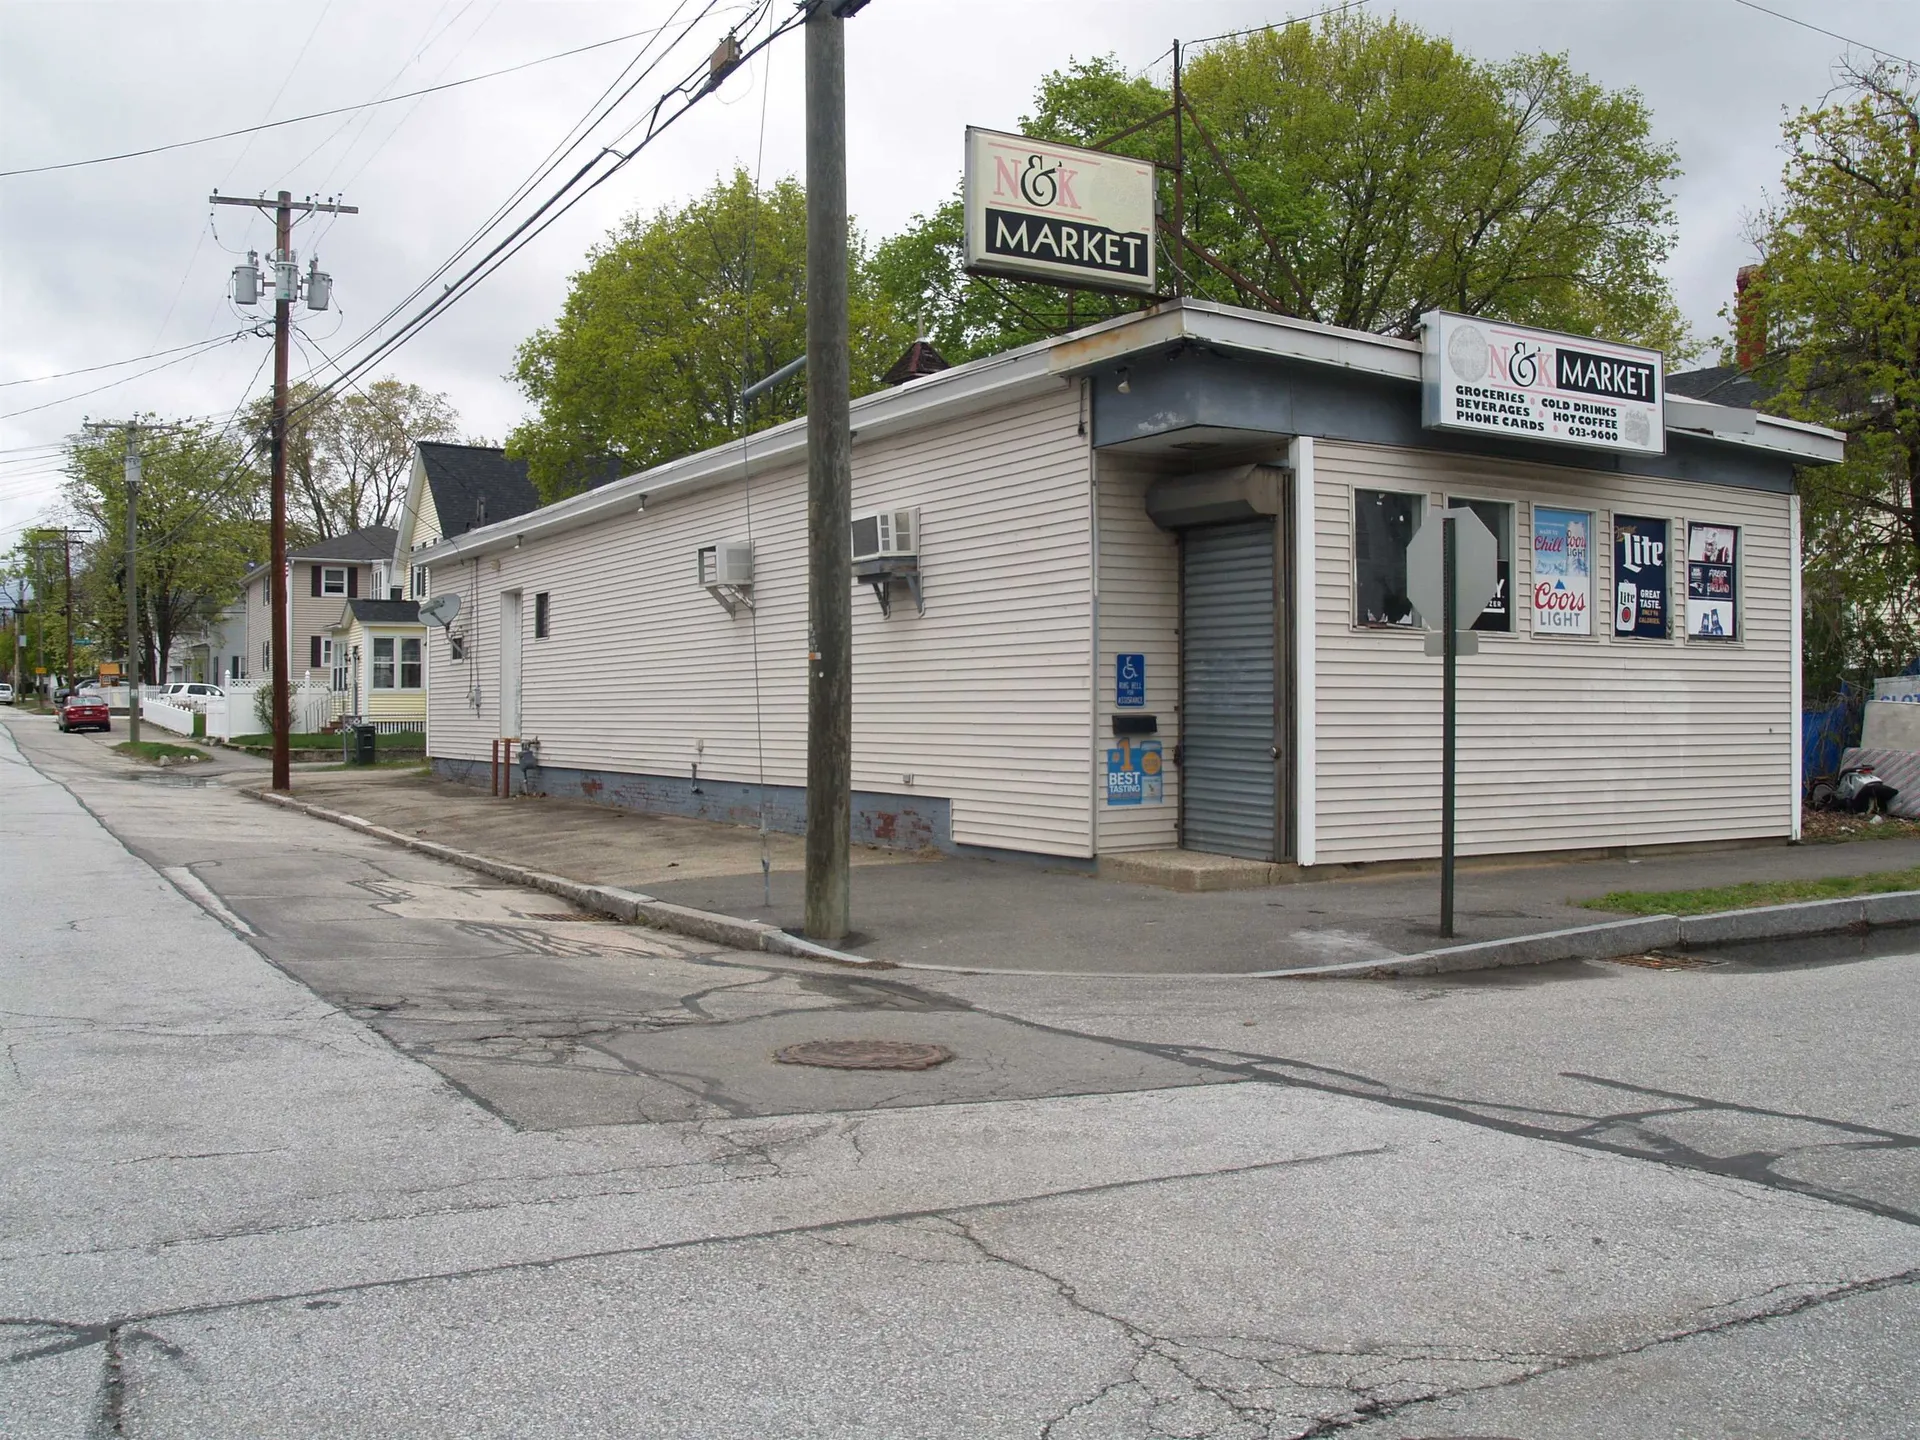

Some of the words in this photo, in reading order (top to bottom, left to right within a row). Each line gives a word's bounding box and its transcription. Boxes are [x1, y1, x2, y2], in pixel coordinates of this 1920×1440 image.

[995, 216, 1141, 268] MARKET
[1562, 355, 1649, 397] MARKET
[1456, 385, 1525, 403] GROCERIES
[1541, 398, 1570, 410] COLD
[1573, 402, 1617, 417] DRINKS
[1456, 398, 1530, 416] BEVERAGES
[1553, 412, 1576, 424] HOT
[1578, 415, 1618, 429] COFFEE
[1456, 410, 1499, 425] PHONE
[1502, 417, 1544, 431] CARDS
[1568, 426, 1618, 441] 623-9600
[1535, 535, 1564, 552] Chill
[1567, 548, 1586, 558] LIGHT
[1622, 532, 1663, 573] Lite
[1535, 582, 1586, 611] Coors
[1620, 591, 1636, 606] Lite
[1640, 589, 1661, 599] GREAT
[1640, 599, 1661, 609] TASTE.
[1540, 611, 1580, 627] LIGHT
[1109, 772, 1140, 785] BEST
[1109, 785, 1140, 793] TASTING
